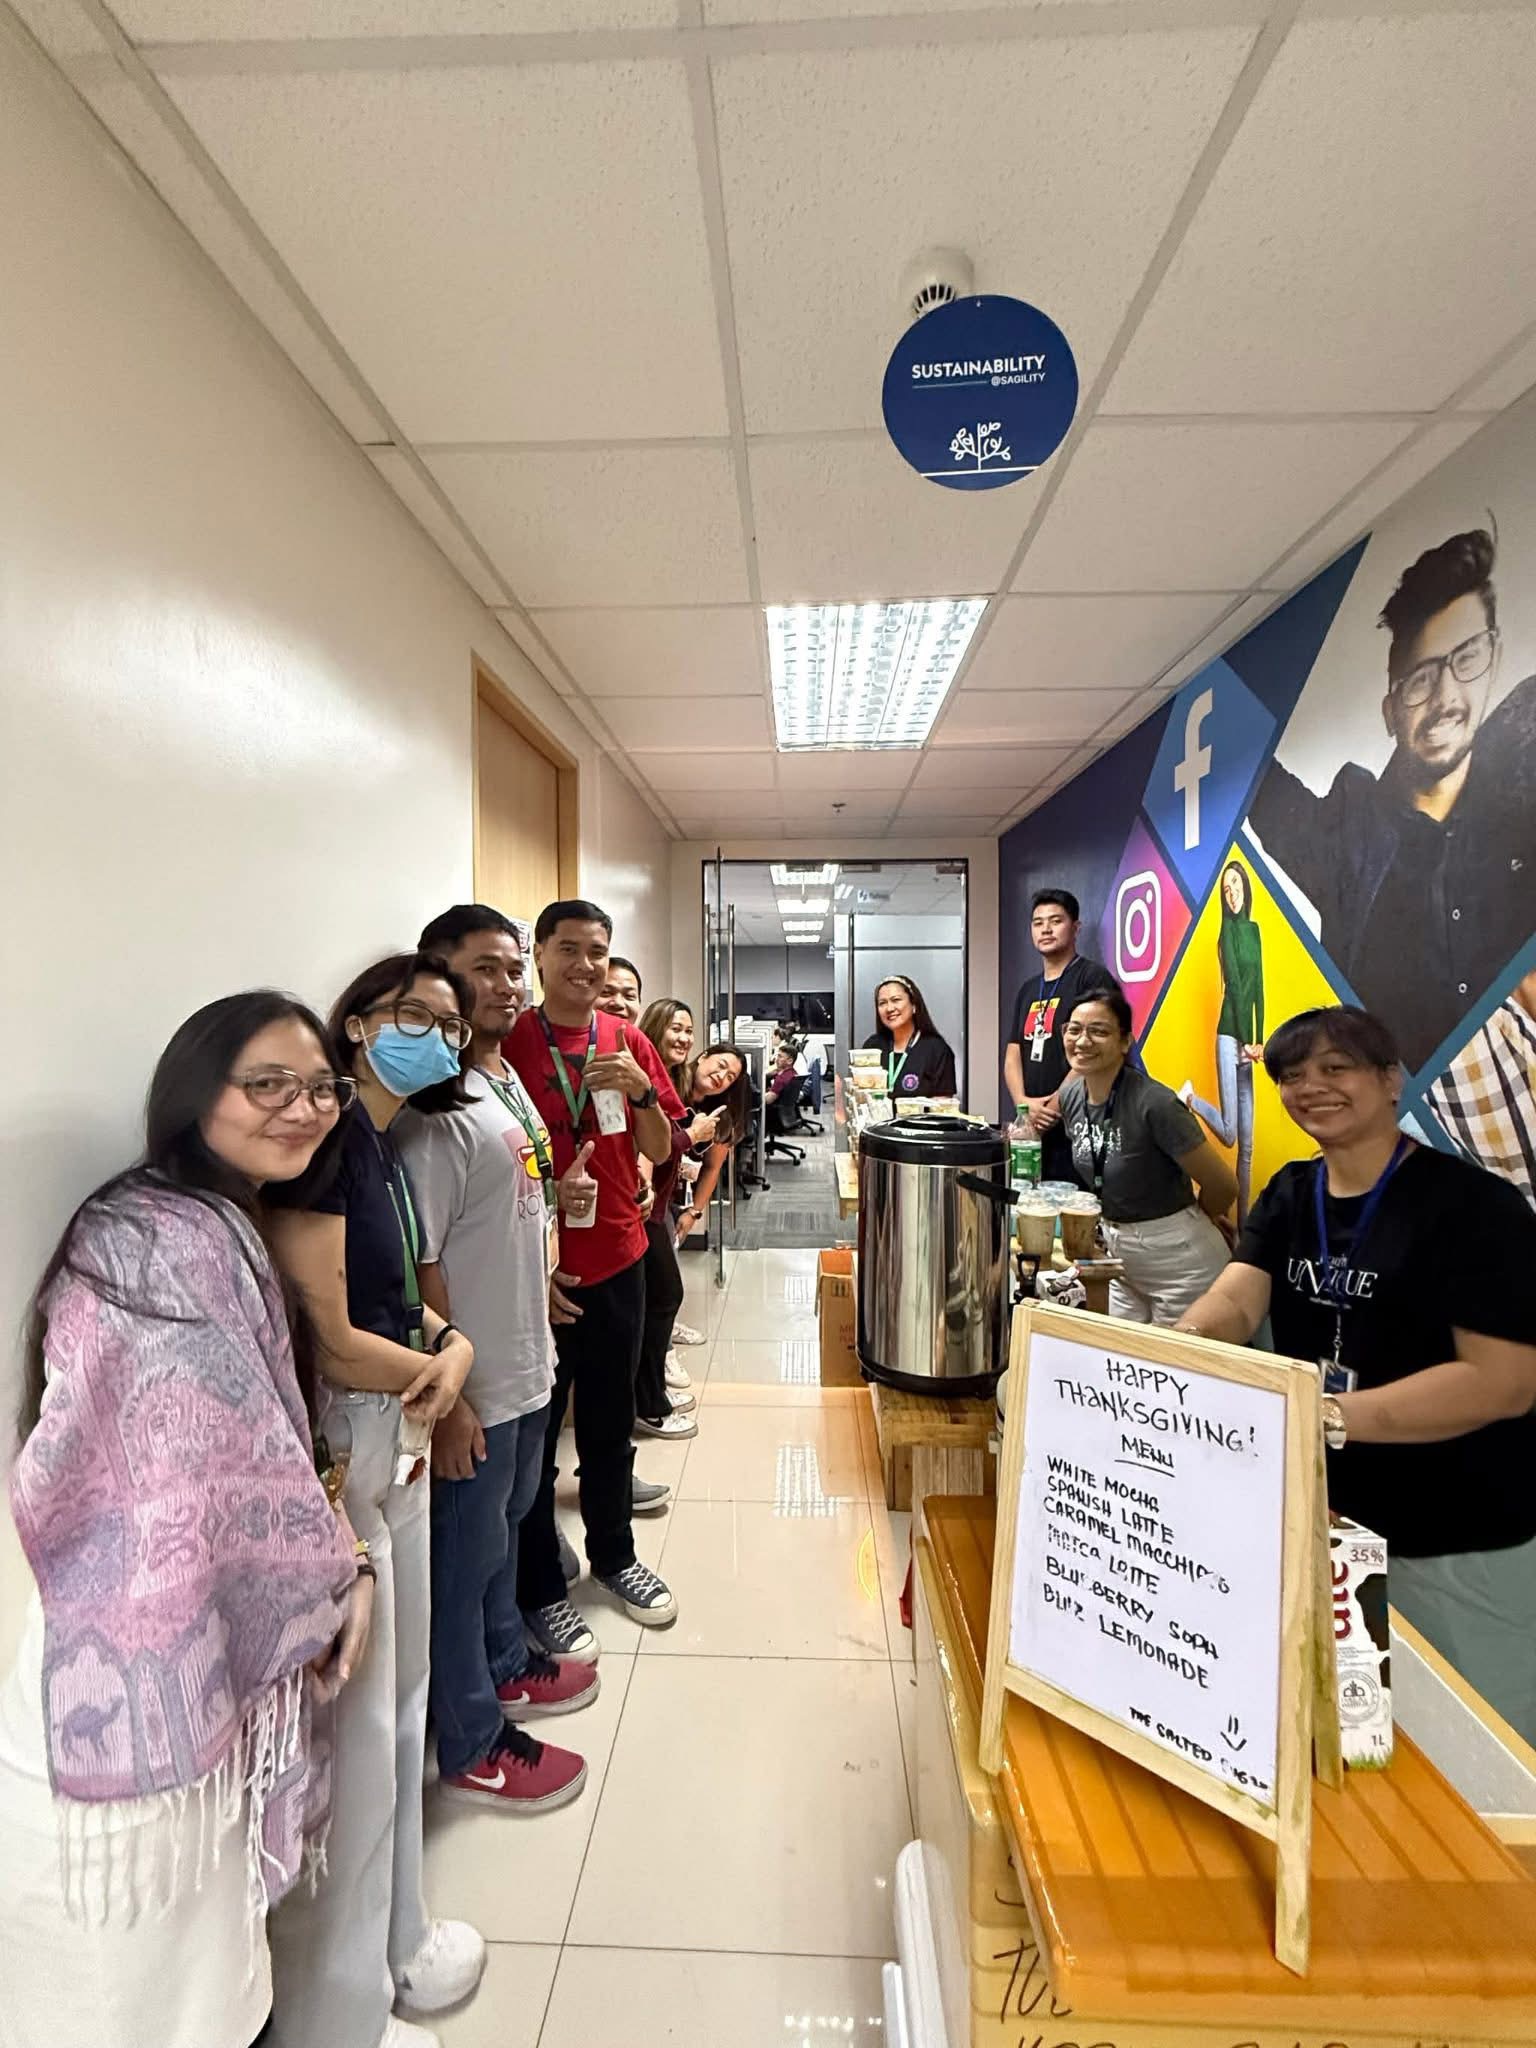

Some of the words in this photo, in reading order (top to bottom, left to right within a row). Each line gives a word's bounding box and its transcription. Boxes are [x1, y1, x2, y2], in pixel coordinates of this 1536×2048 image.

[911, 355, 1046, 379] SUSTAINABILITY
[991, 373, 1046, 387] @SAGILITY
[1121, 1433, 1175, 1468] MENU
[1046, 1454, 1098, 1489] WHITE
[1043, 1495, 1122, 1545] CARAMEL
[1126, 1532, 1231, 1595] MACCHIAO
[1121, 1507, 1175, 1546] LATTE
[1046, 1554, 1155, 1624] BLUBERRY
[1098, 1613, 1210, 1690] LEMONADE
